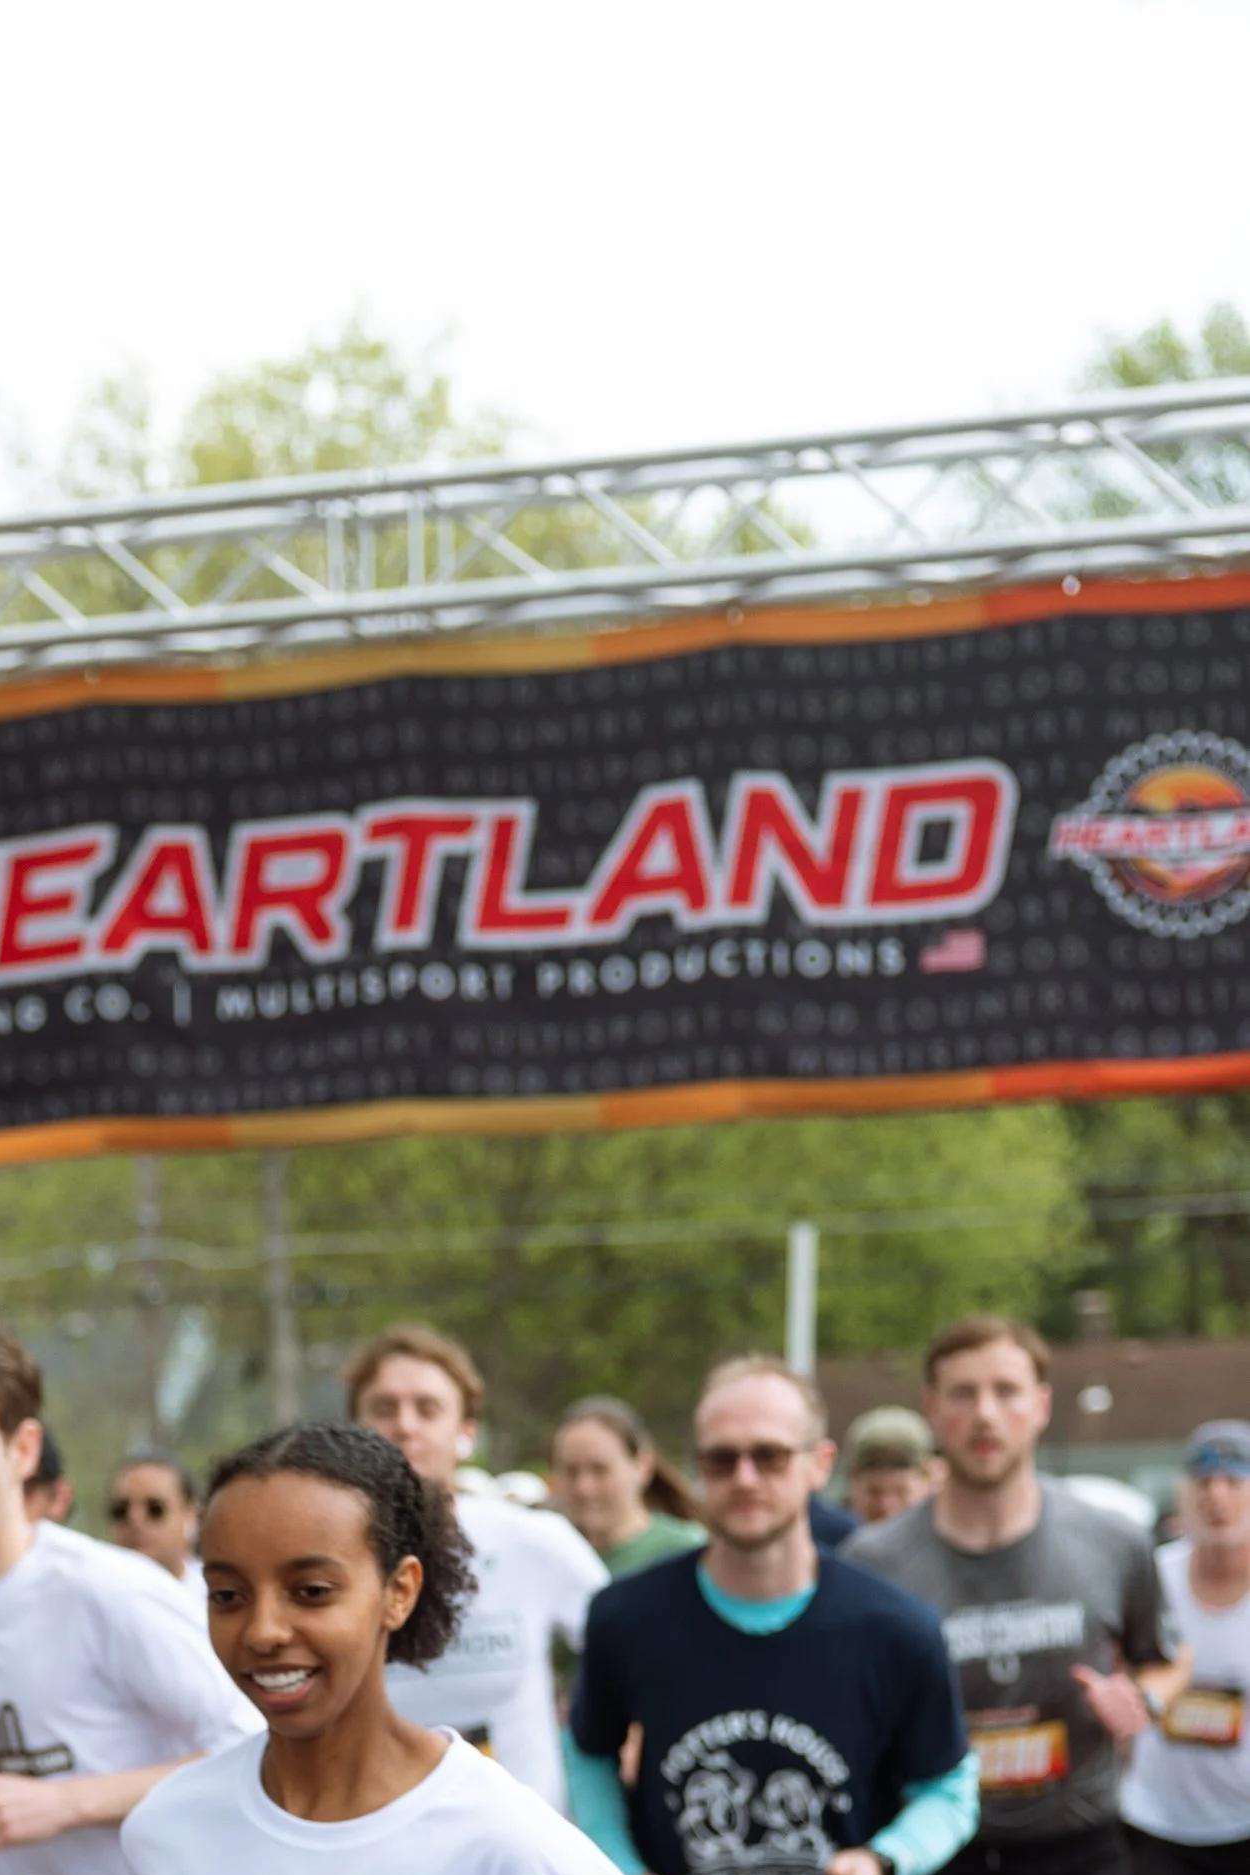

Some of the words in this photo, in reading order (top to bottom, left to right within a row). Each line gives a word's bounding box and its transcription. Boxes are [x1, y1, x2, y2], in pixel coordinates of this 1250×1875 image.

[63, 982, 150, 1025] CO.
[216, 960, 513, 1022] MULTISPORT
[537, 936, 906, 999] PRODUCTIONS
